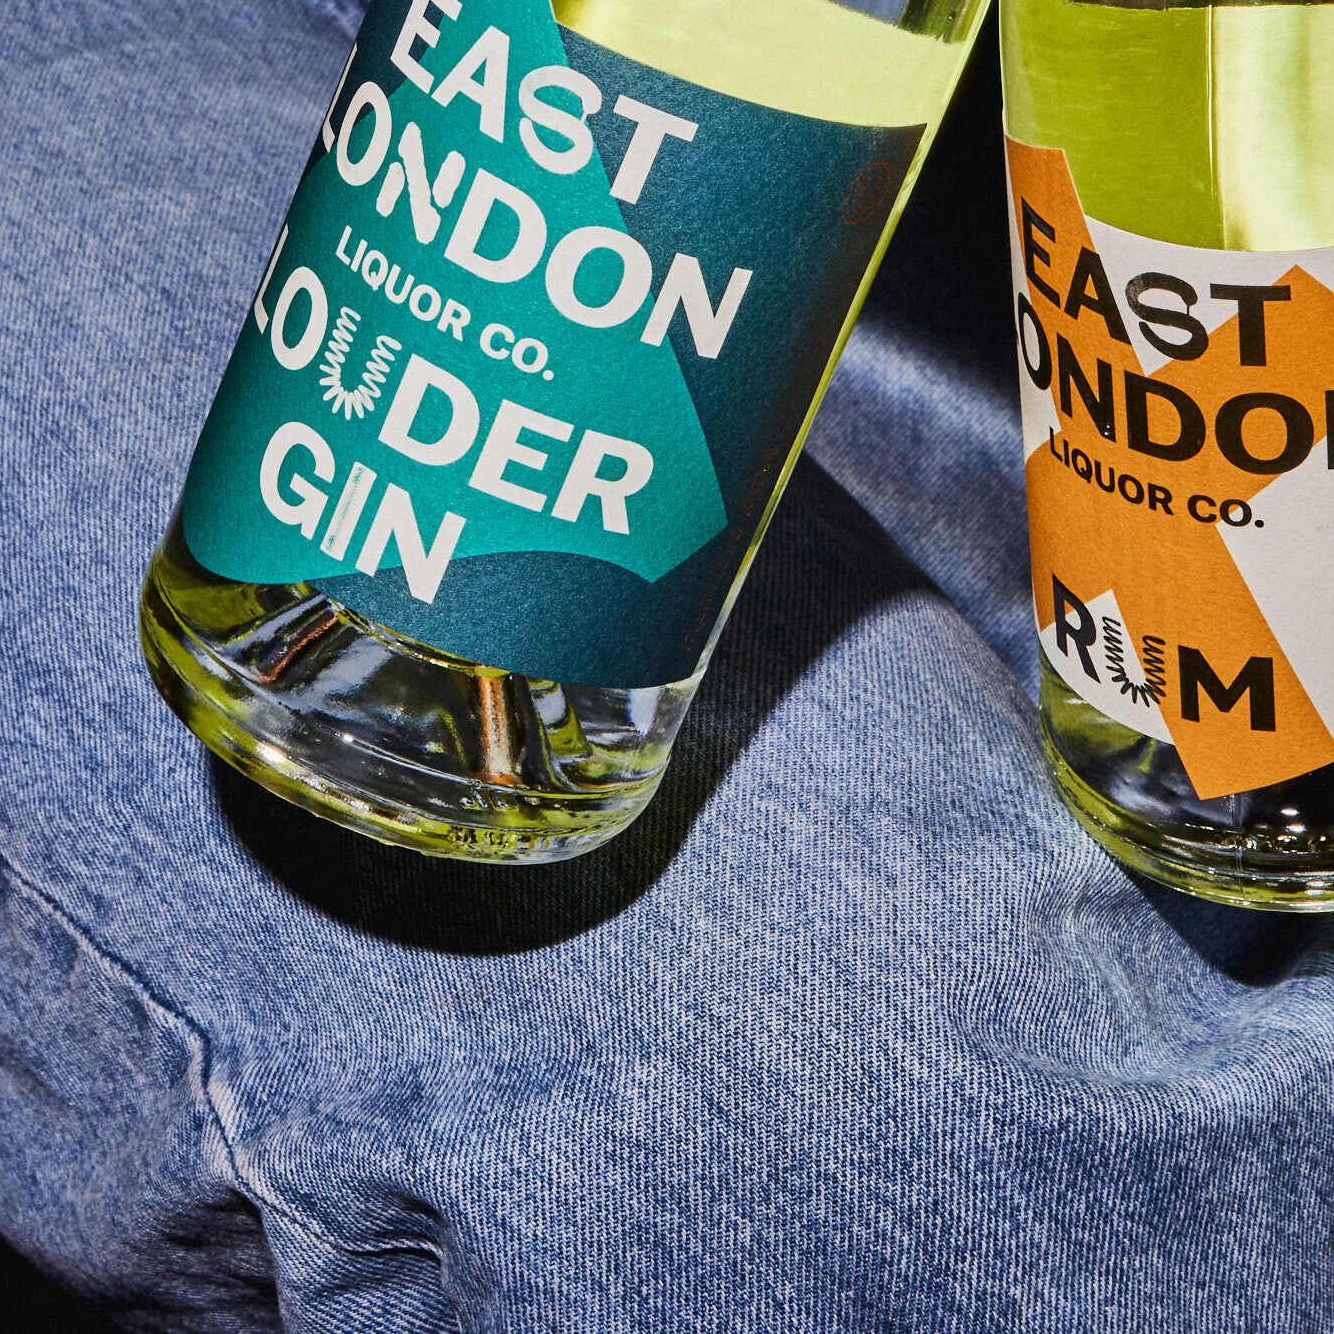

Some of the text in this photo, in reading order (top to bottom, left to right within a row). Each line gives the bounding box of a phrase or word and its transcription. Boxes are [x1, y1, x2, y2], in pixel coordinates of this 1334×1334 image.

[322, 42, 754, 360] LONDON
[1021, 197, 1291, 367] EAST
[254, 223, 655, 536] LOUDER
[336, 225, 555, 382] LIQUOR CO.
[259, 421, 466, 605] GIN
[1050, 426, 1265, 529] LIQUOR CO.
[1051, 573, 1276, 732] RUM
